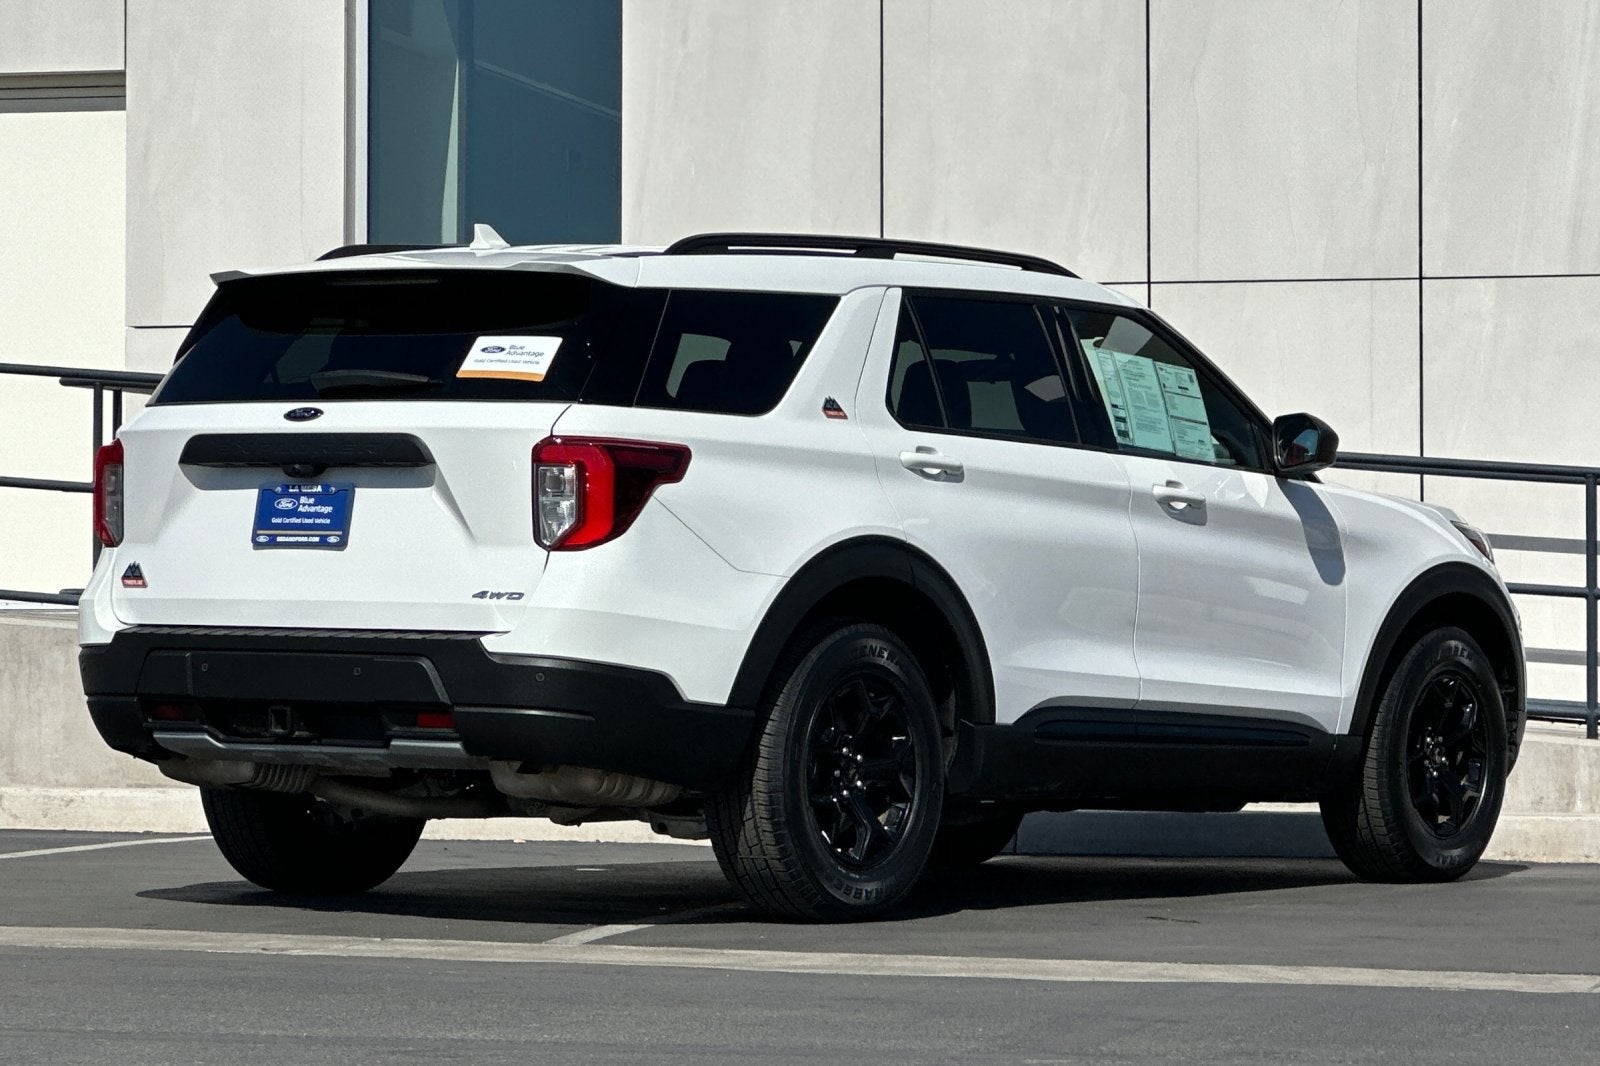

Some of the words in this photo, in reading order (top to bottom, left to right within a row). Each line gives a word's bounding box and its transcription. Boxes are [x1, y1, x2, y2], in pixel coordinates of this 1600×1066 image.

[299, 496, 315, 504] Blue
[297, 505, 333, 513] Advantage
[472, 590, 525, 600] 4WD
